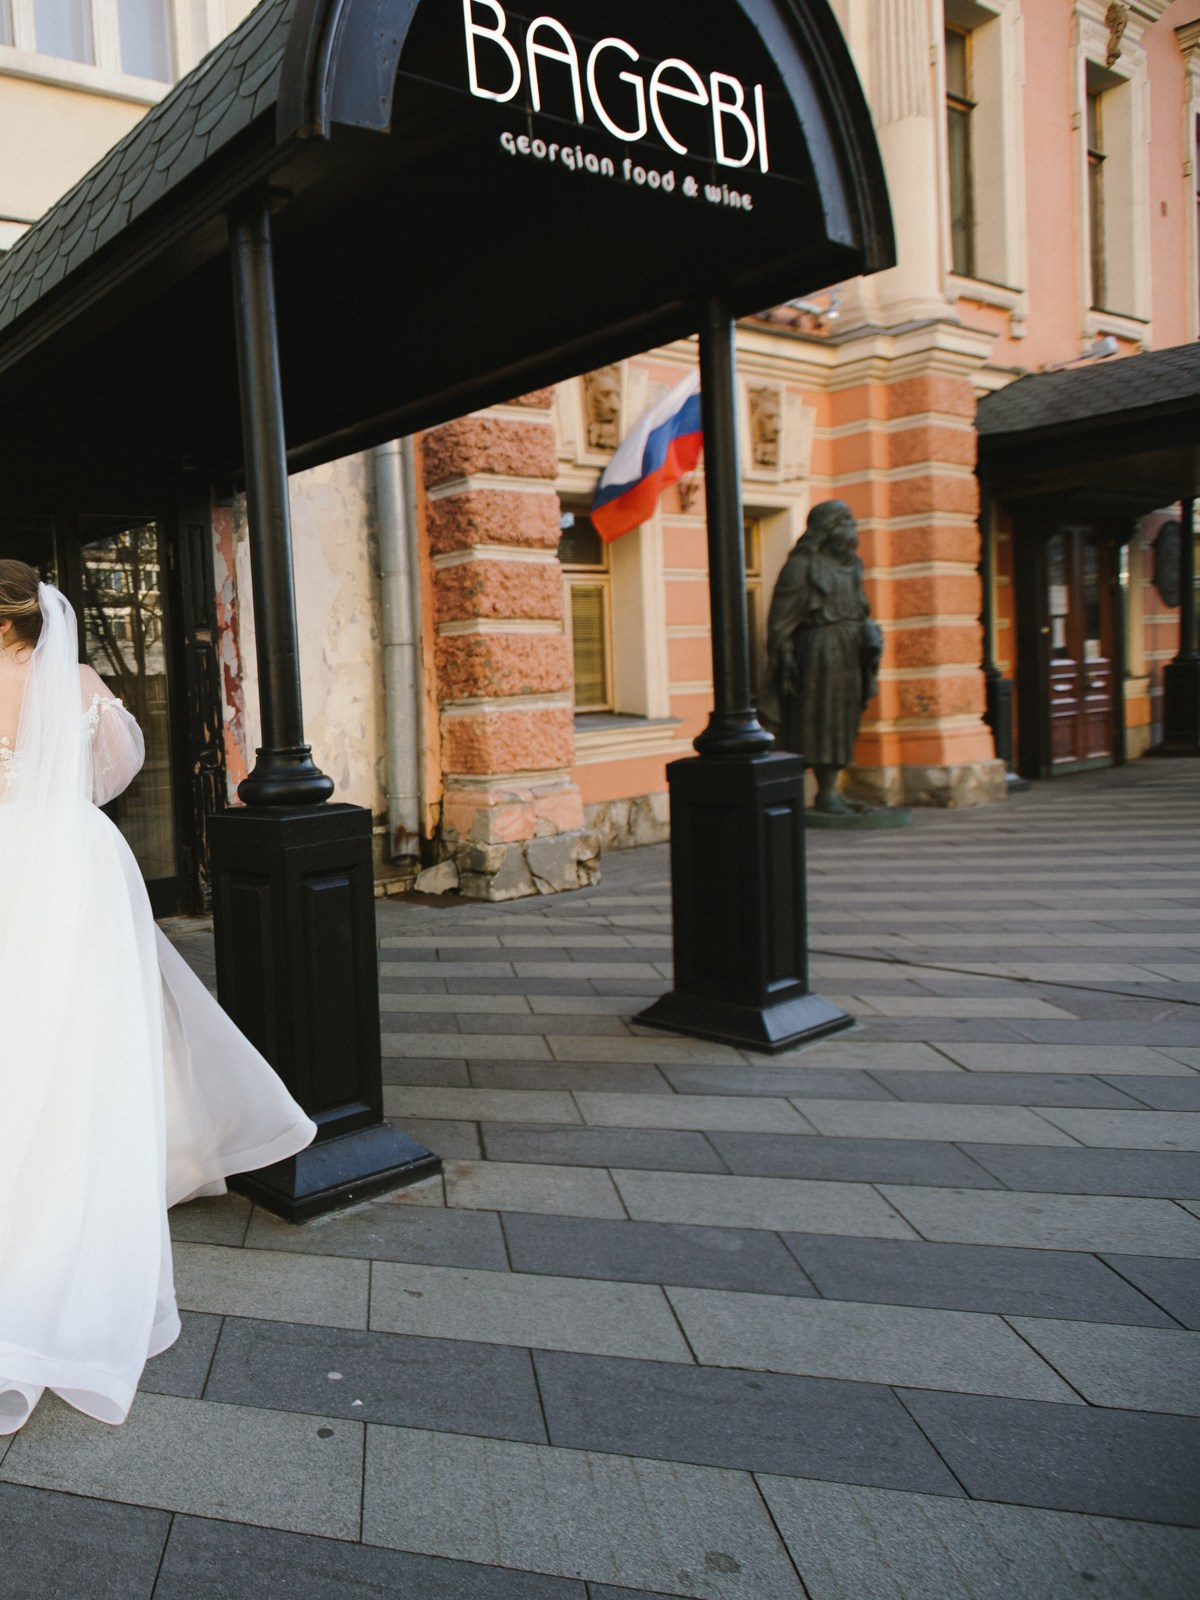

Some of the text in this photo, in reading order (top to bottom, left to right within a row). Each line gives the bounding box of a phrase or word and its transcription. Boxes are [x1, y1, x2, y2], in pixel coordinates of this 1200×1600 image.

[500, 131, 753, 212] georgian food & wine
